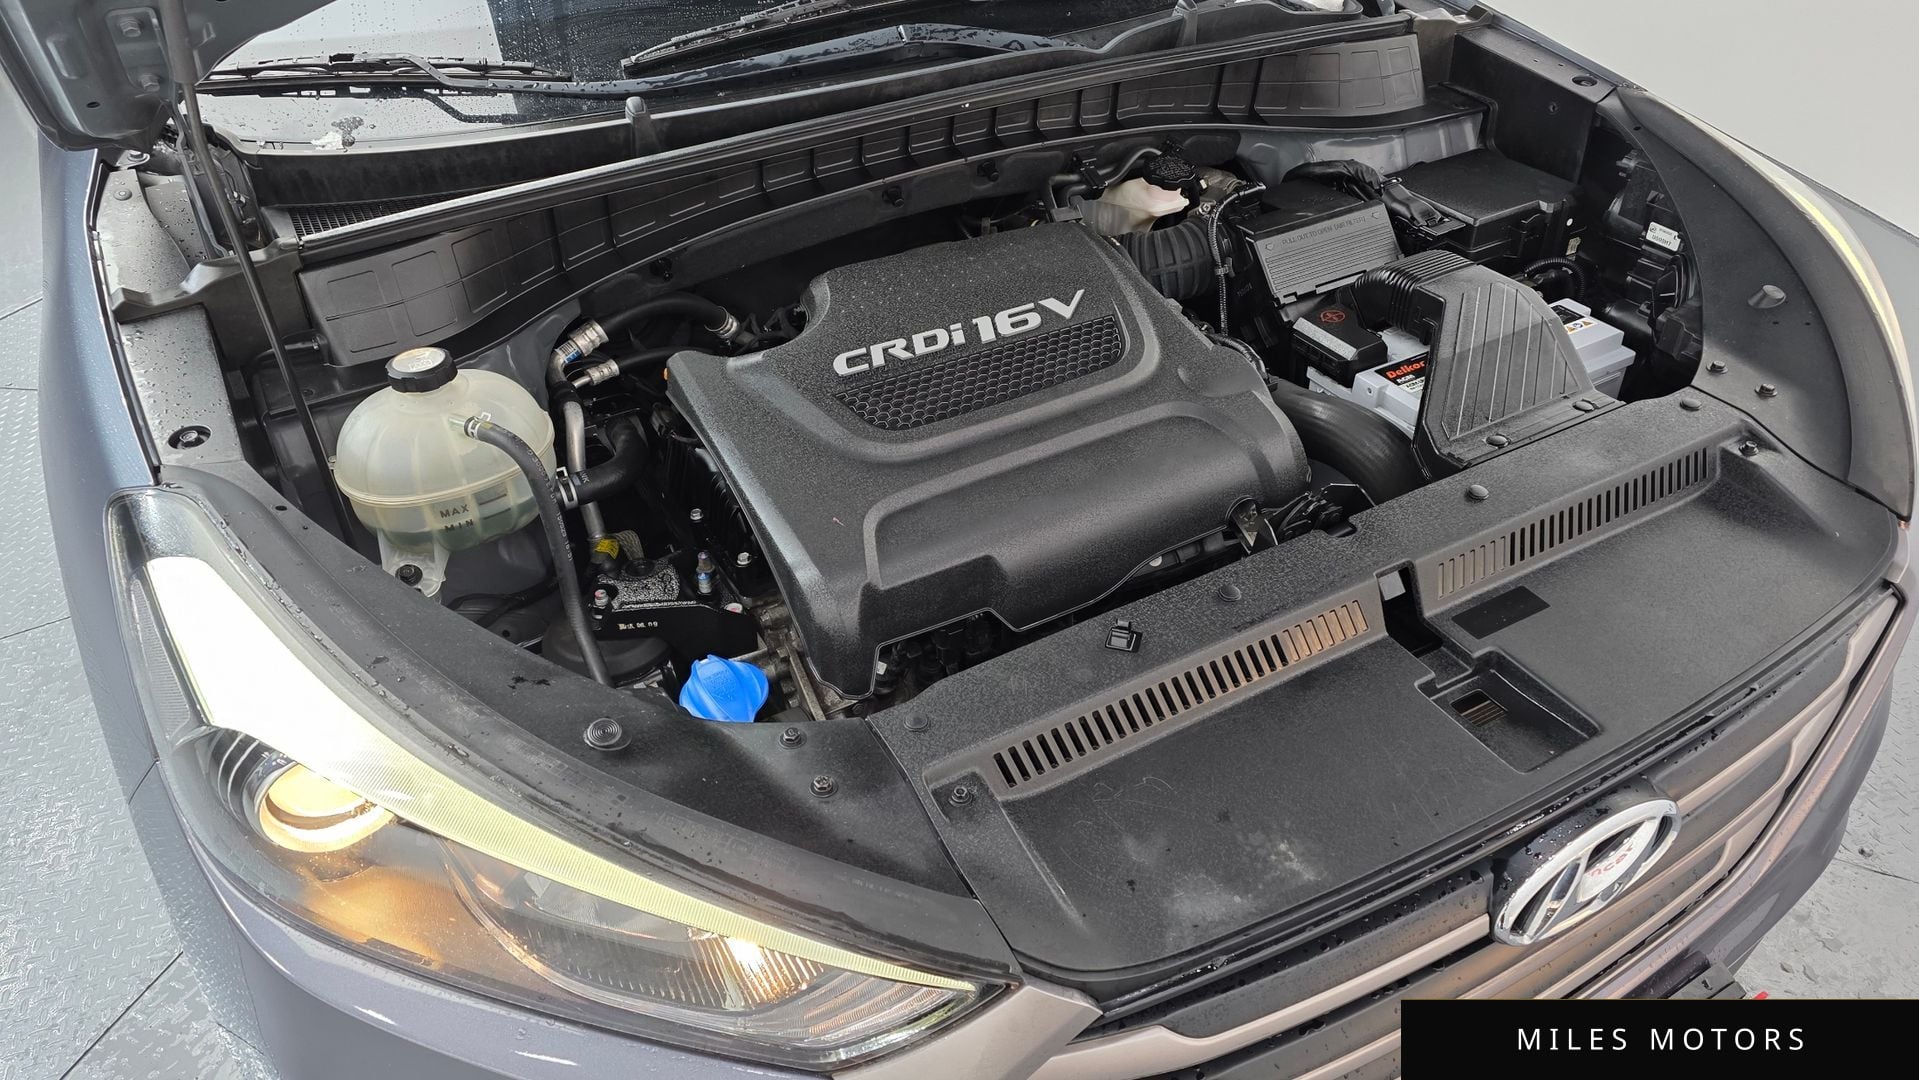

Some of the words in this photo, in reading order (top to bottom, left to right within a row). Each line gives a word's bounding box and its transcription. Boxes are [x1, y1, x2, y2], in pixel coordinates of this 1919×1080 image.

[833, 323, 966, 377] CRDi
[972, 289, 1085, 344] 16V
[1386, 360, 1426, 379] Delkor
[440, 504, 469, 518] MAX
[444, 519, 474, 532] MIN
